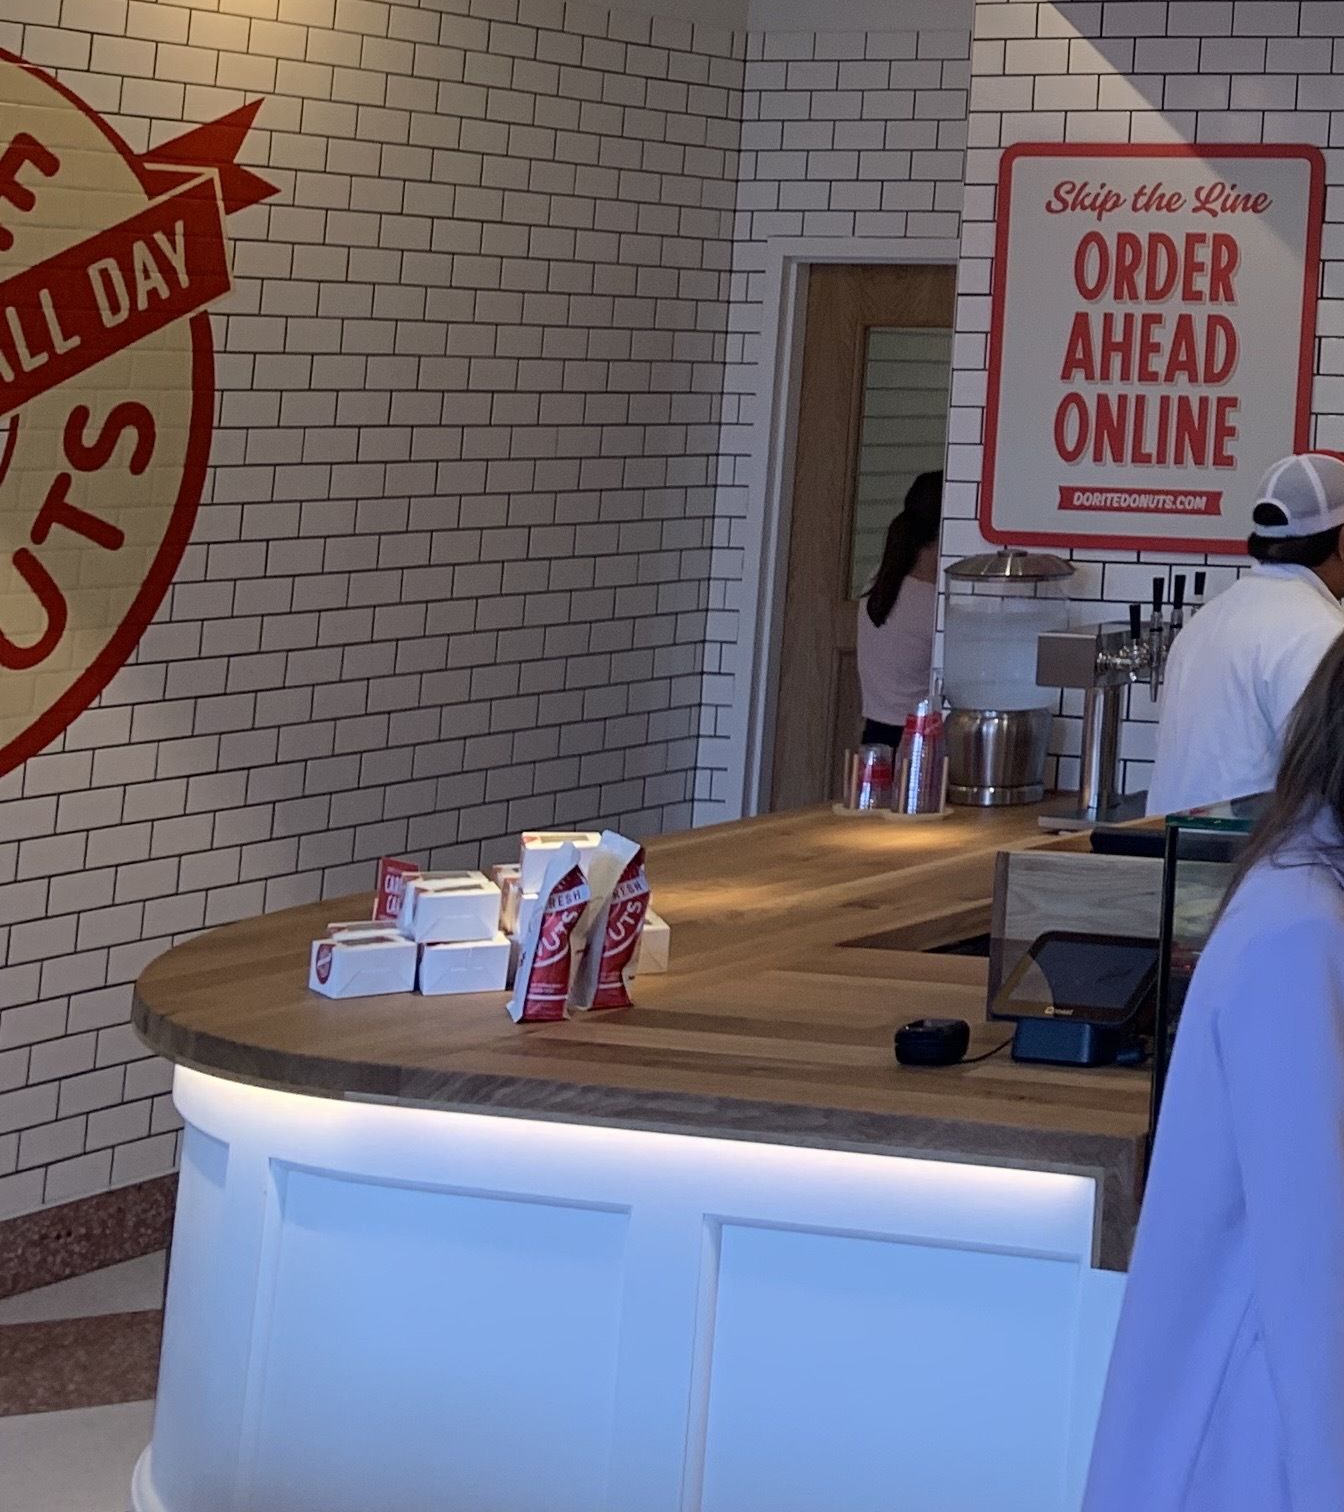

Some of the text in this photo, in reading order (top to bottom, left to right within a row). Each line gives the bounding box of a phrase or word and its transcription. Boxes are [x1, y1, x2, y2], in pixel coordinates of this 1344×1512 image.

[1045, 181, 1273, 221] Skip the Line
[87, 220, 191, 328] DAY
[1074, 231, 1239, 303] ORDER
[1060, 312, 1239, 384] AHEAD
[1054, 392, 1239, 468] ONLINE
[1073, 492, 1207, 511] DORITEDONUTS.COM
